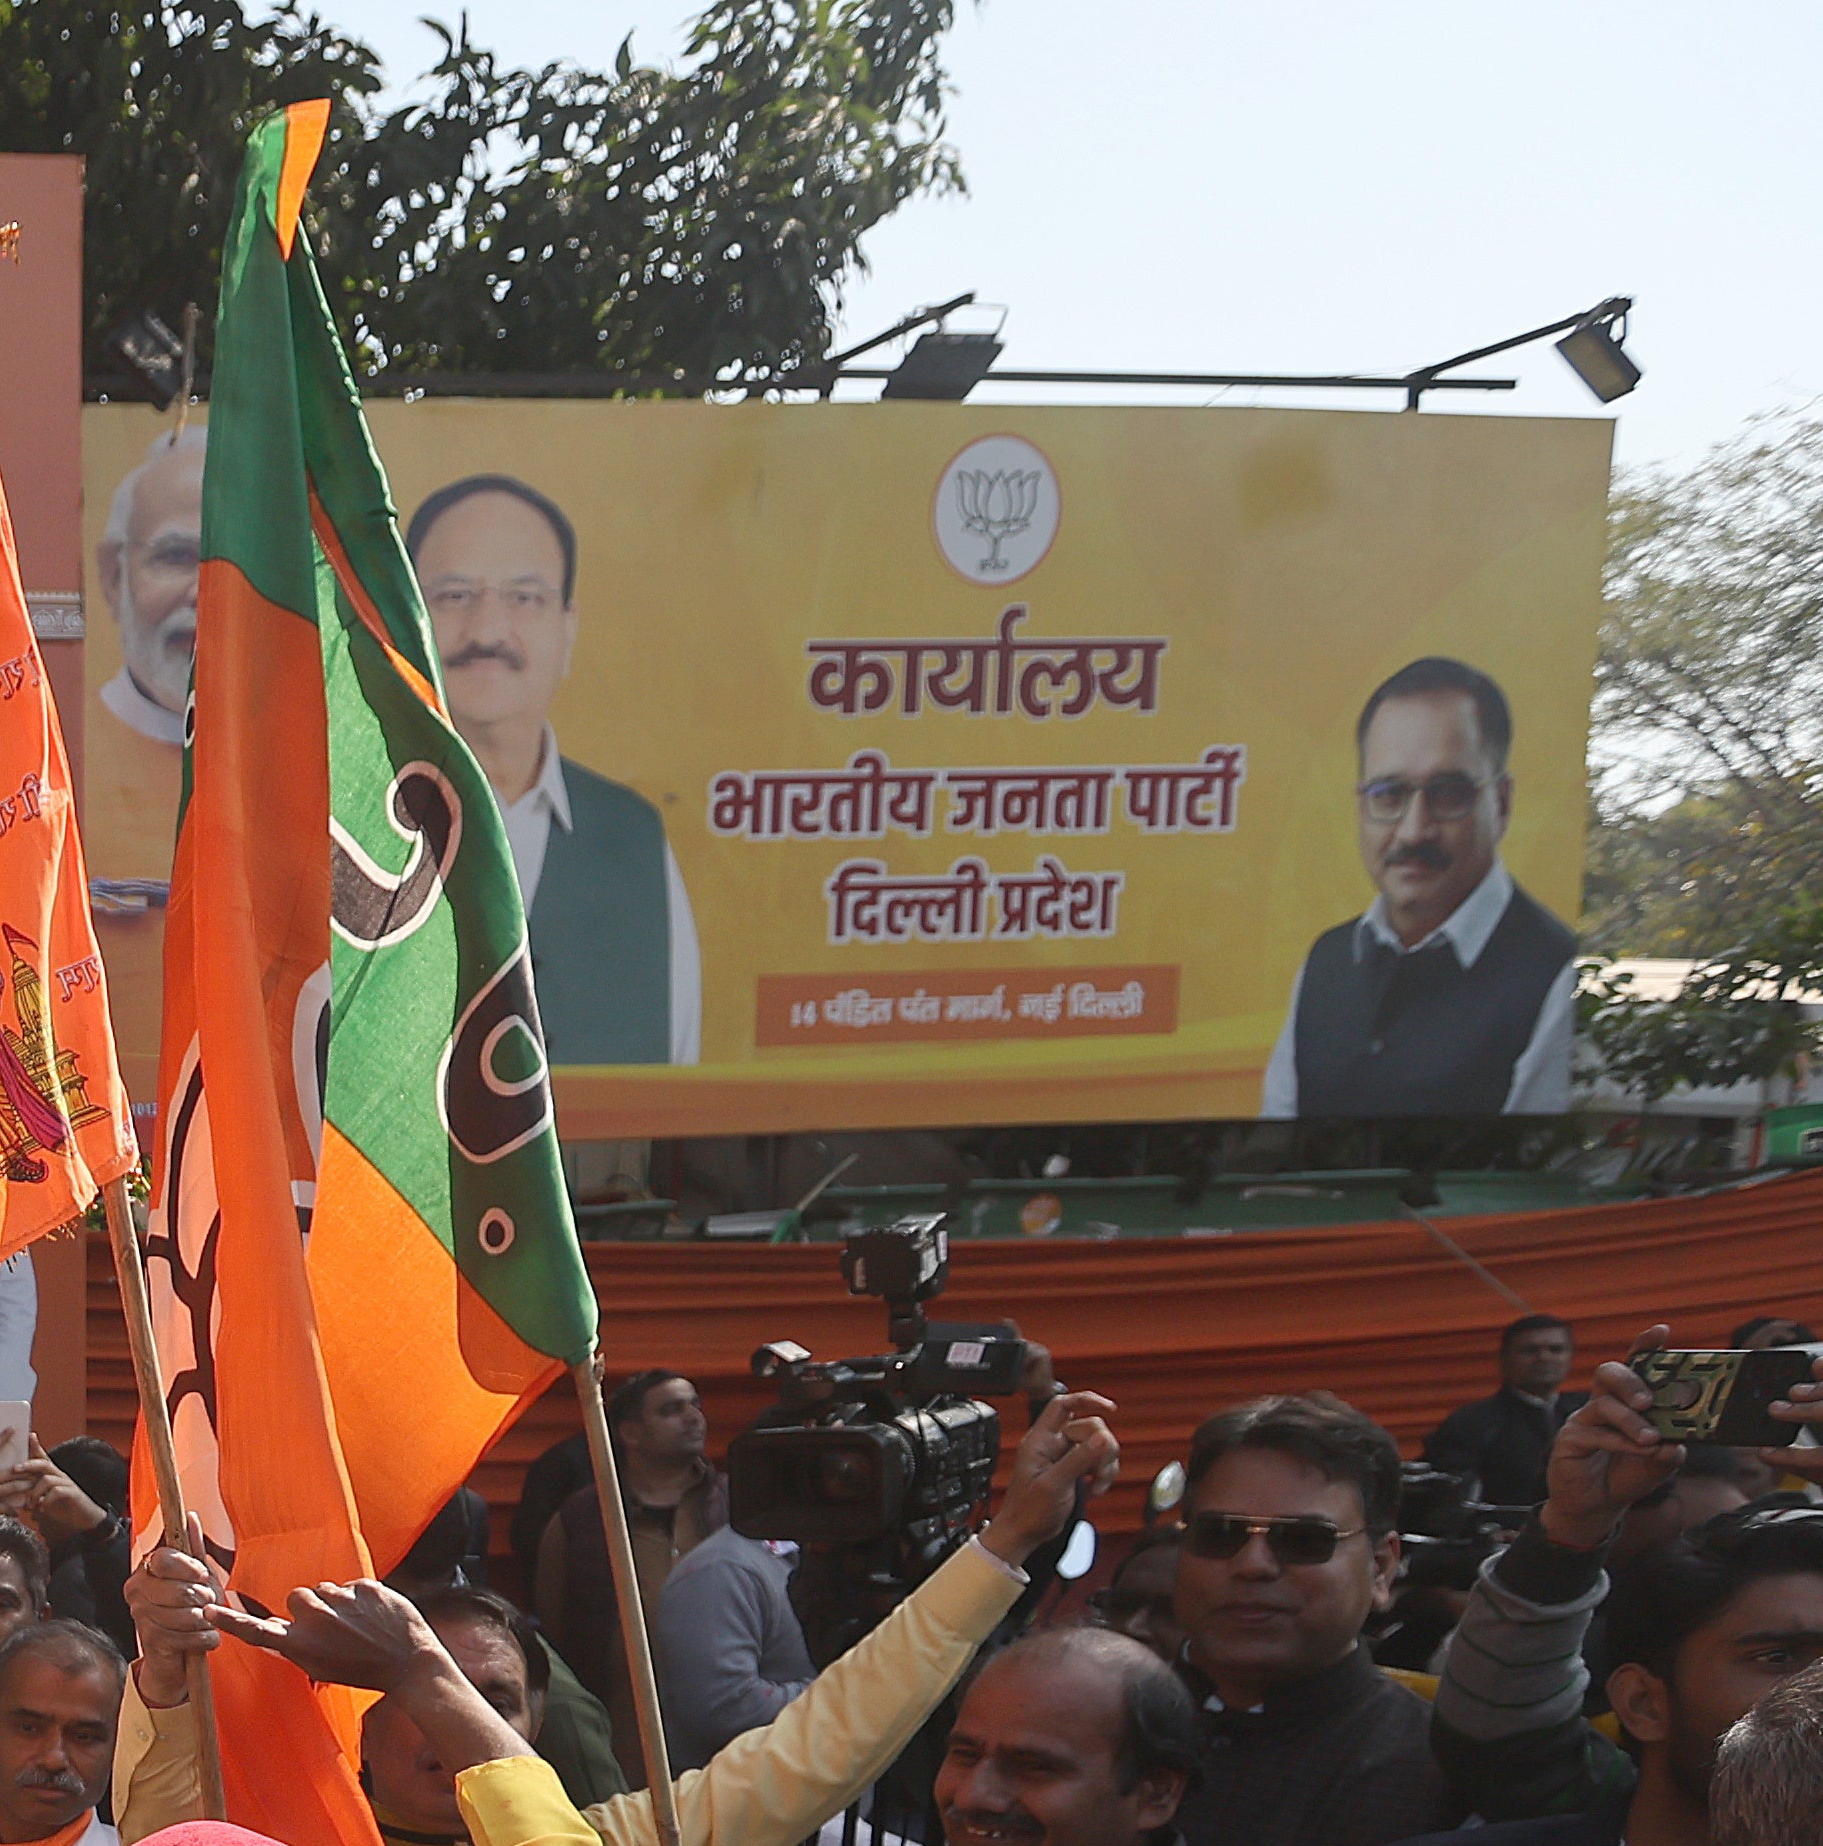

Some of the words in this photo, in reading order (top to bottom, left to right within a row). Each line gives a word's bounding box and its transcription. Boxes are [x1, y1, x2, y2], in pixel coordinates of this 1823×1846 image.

[806, 602, 1171, 719] कार्यालय
[707, 748, 936, 840] भारतीय
[945, 765, 1115, 837] जनता
[1123, 744, 1248, 833] पार्टी
[825, 856, 989, 943] दिल्ली
[993, 853, 1126, 942] प्रदेश
[790, 1000, 817, 1028] 14
[1017, 982, 1066, 1022] नई
[1067, 980, 1146, 1020] दिल्ली
